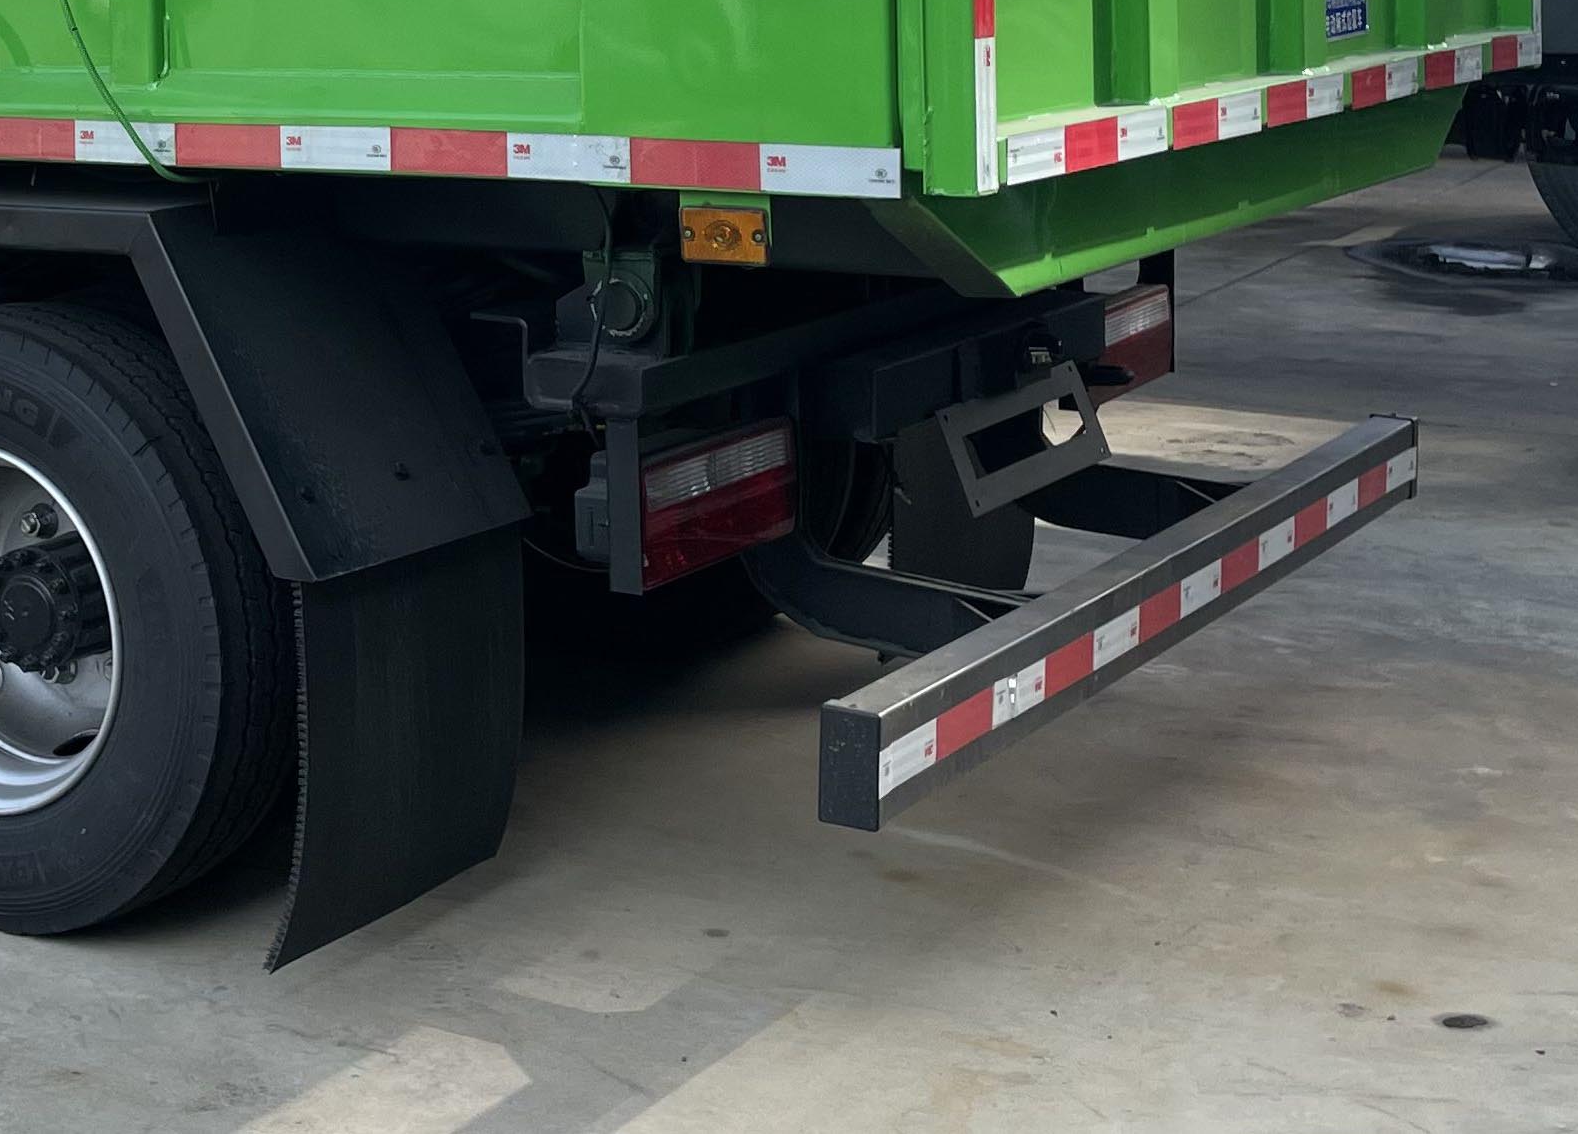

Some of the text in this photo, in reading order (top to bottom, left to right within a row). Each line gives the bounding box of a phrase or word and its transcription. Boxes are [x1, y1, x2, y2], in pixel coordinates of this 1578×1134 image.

[79, 130, 95, 140] 3M
[286, 136, 302, 146] 3M
[513, 144, 531, 155] 3M
[766, 156, 786, 167] 3M
